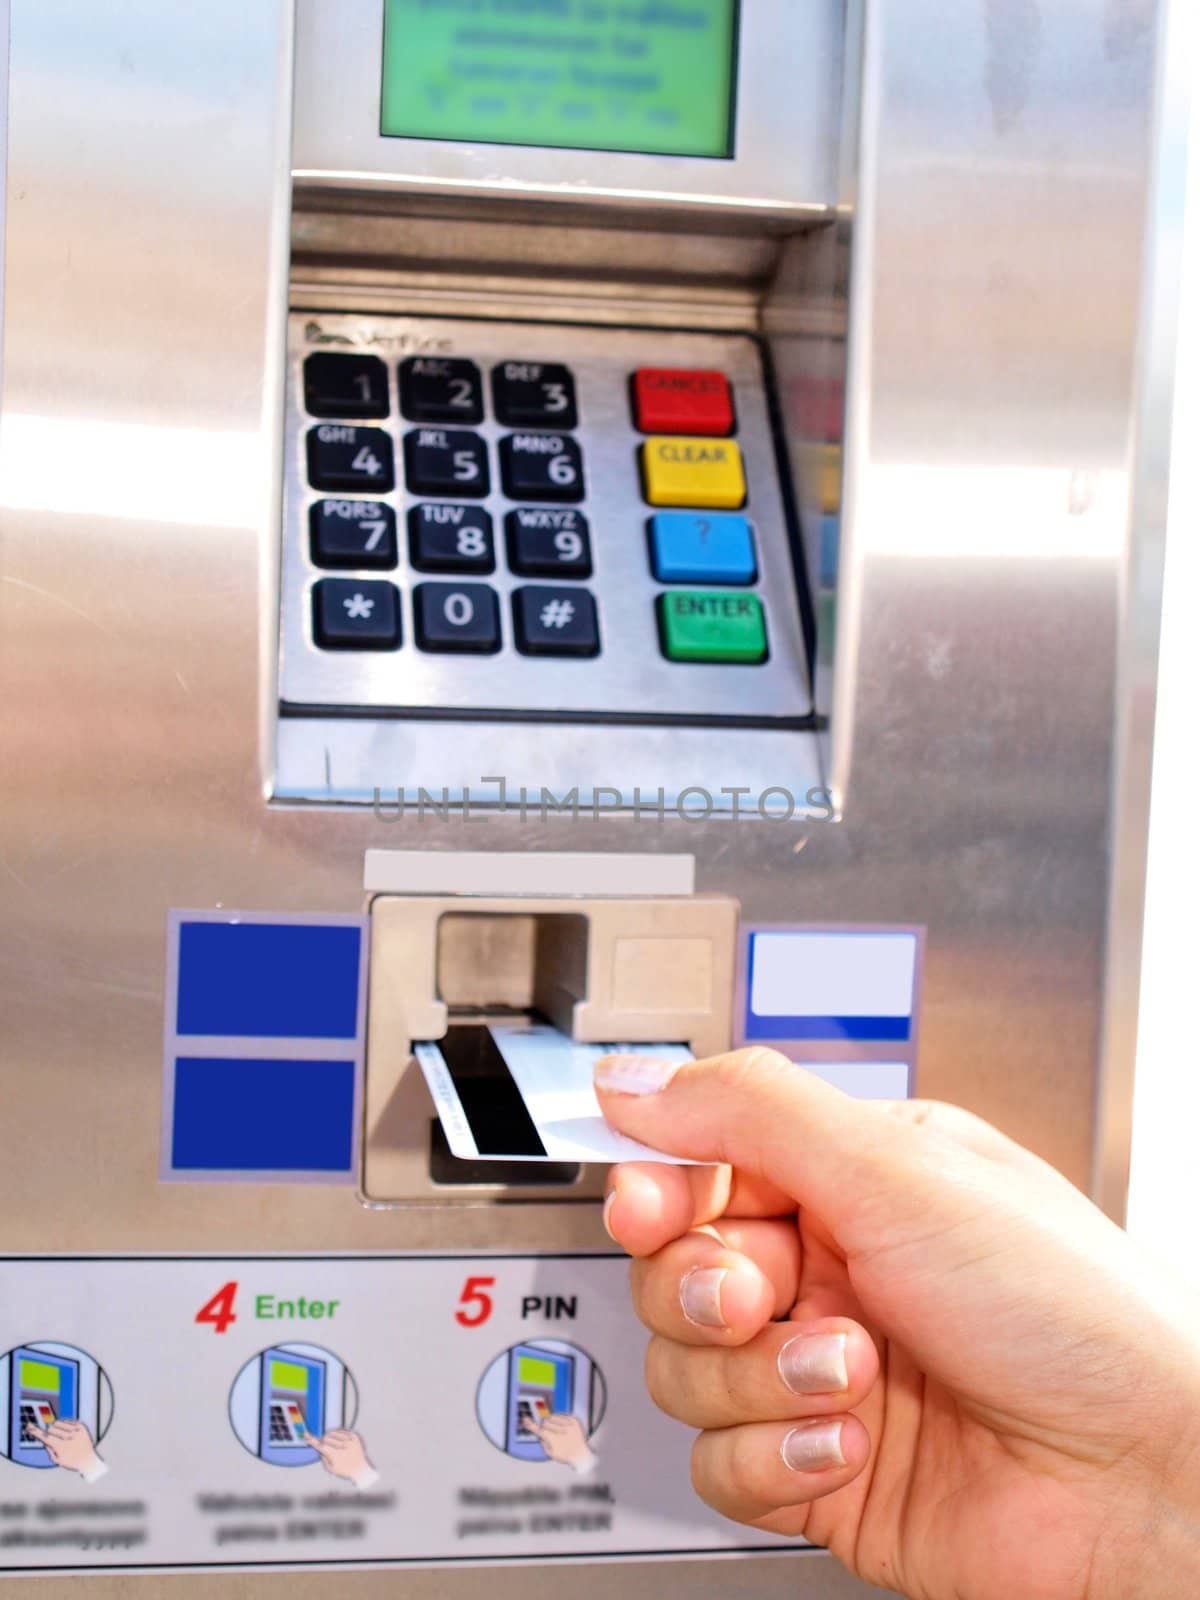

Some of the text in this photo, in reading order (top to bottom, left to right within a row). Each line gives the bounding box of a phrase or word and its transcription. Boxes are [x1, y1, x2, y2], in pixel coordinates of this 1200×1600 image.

[412, 359, 452, 376] ABC
[504, 363, 542, 381] DEF
[355, 373, 372, 401] 1
[449, 378, 473, 408] 2
[541, 383, 568, 412] 3
[643, 374, 722, 393] CANCEL
[318, 426, 355, 444] GHI
[417, 430, 449, 449] JKL
[512, 436, 564, 454] MNO
[351, 446, 382, 476] 4
[453, 451, 479, 481] 5
[658, 445, 728, 464] CLEAR
[548, 455, 576, 484] 6
[323, 501, 382, 519] PQRS
[421, 504, 466, 524] TUV
[517, 509, 577, 529] WXYZ
[358, 521, 388, 551] 7
[456, 526, 487, 557] 8
[554, 530, 583, 561] 9
[443, 593, 474, 625] 0
[673, 595, 754, 617] ENTER
[194, 1280, 340, 1334] 4 Enter
[454, 1275, 578, 1328] 5 PIN
